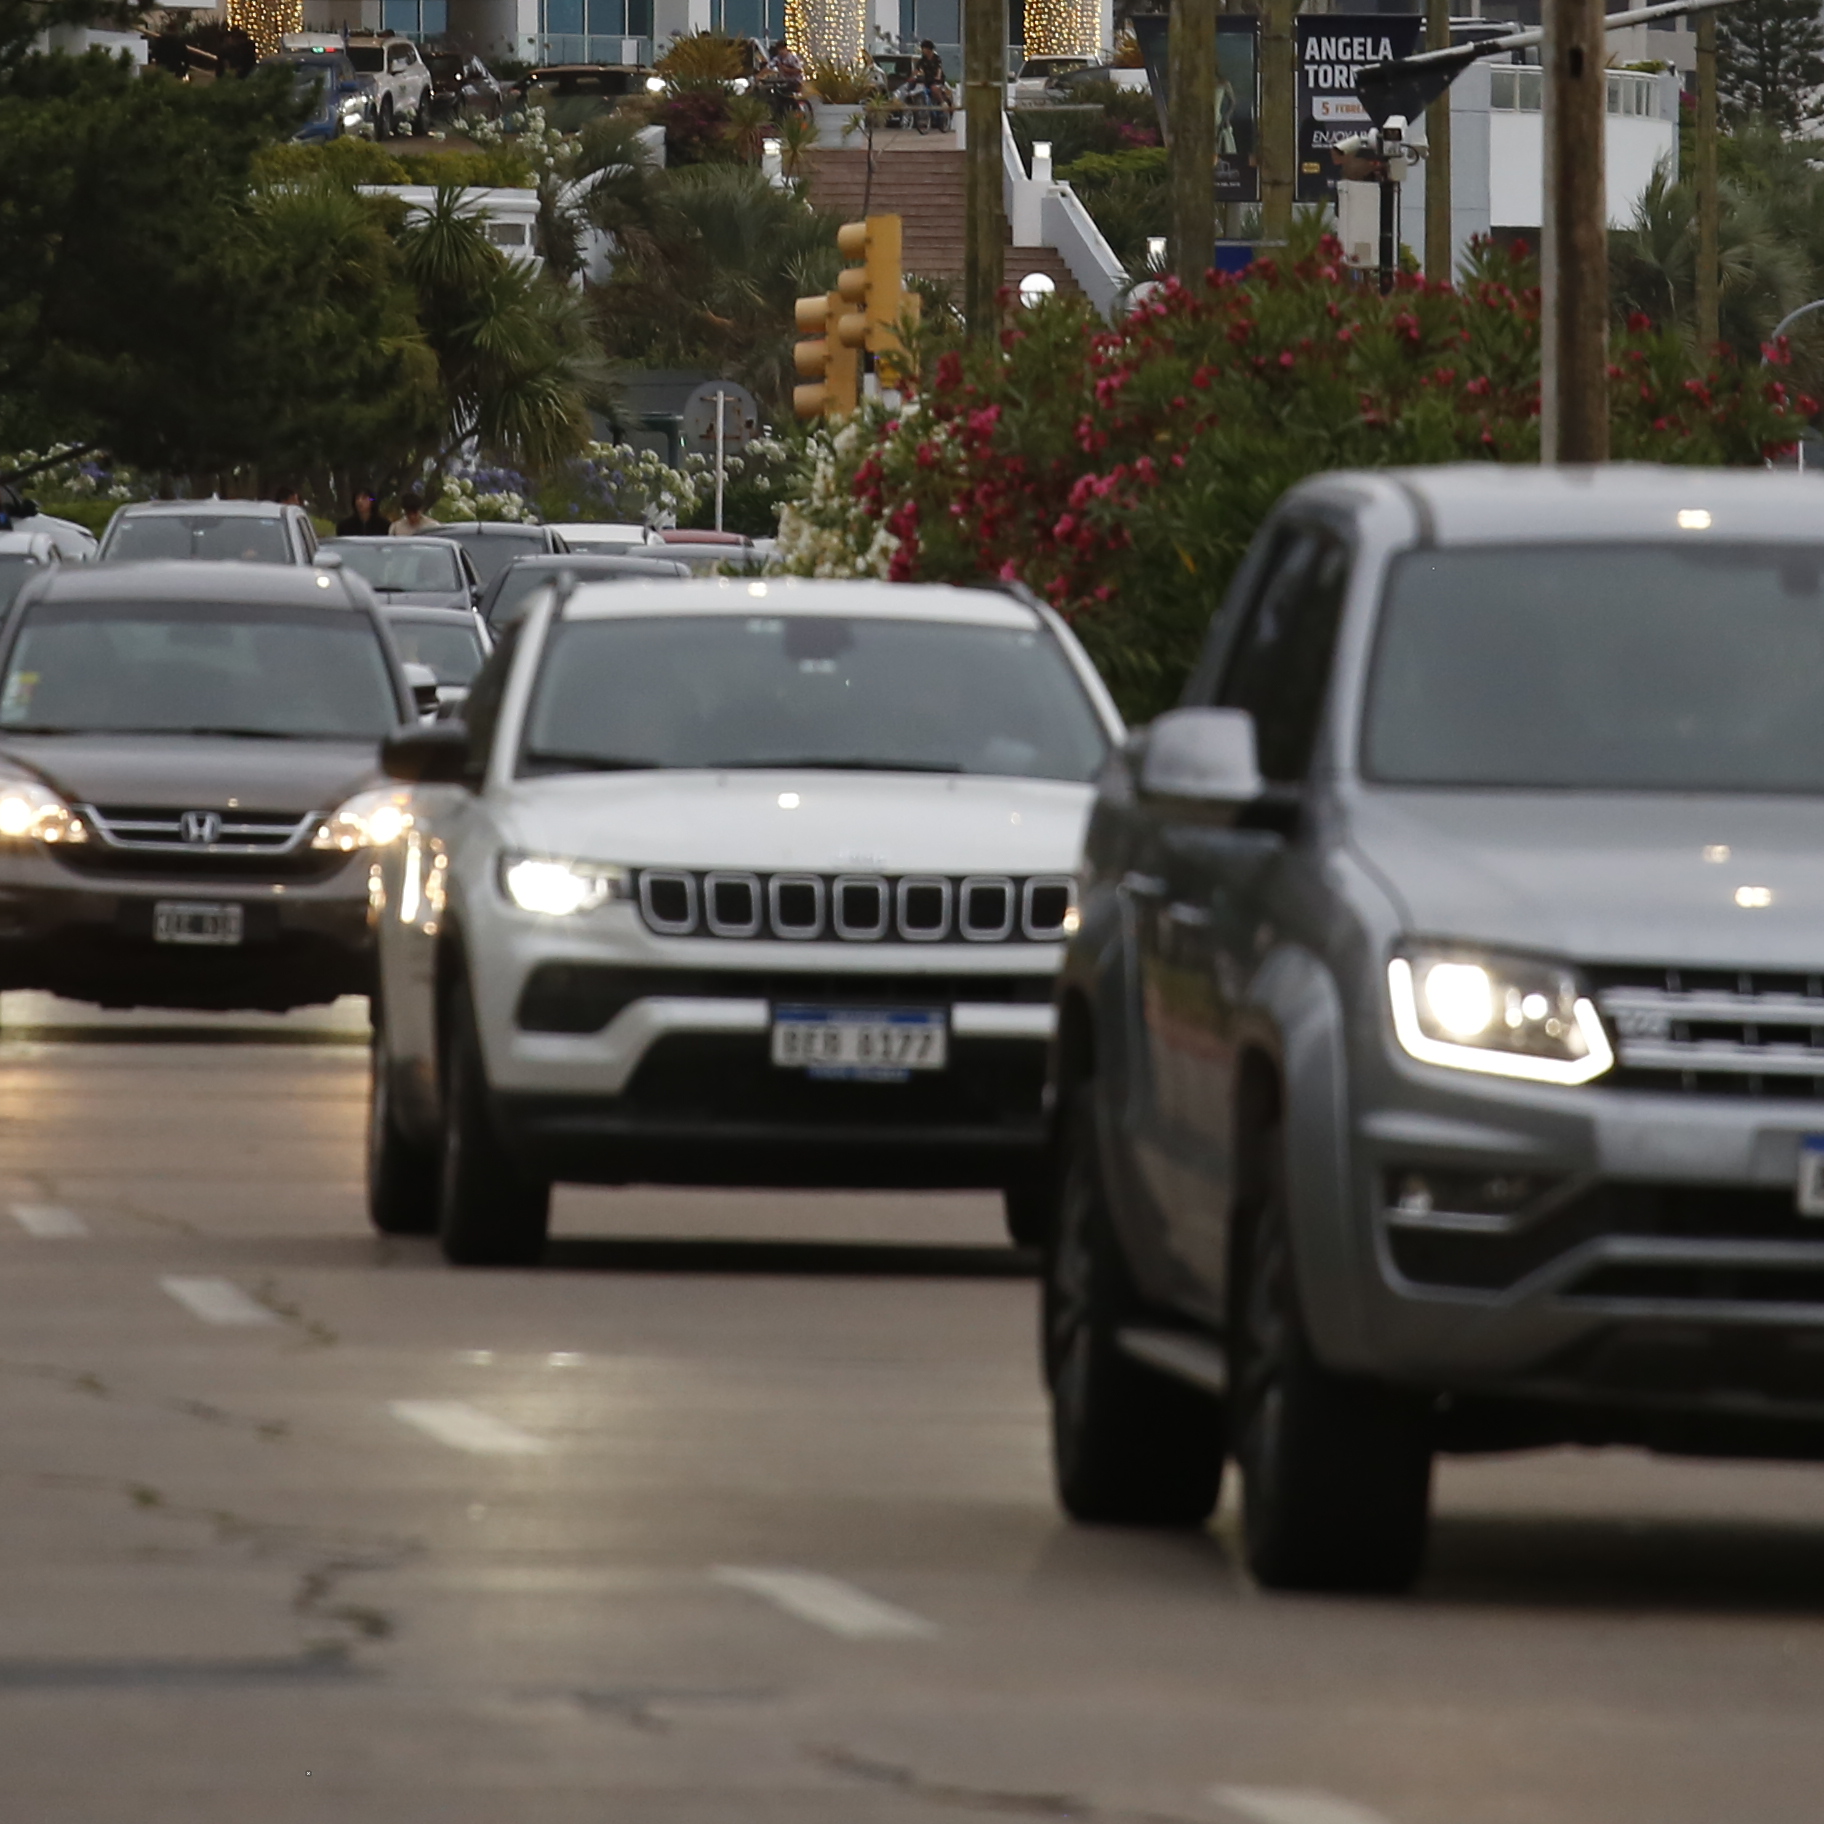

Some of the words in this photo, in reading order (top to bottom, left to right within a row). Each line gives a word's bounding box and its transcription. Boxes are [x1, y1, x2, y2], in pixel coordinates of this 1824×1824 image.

[1304, 36, 1394, 61] ANGELA
[1304, 64, 1364, 89] TORR
[1321, 101, 1330, 115] 5
